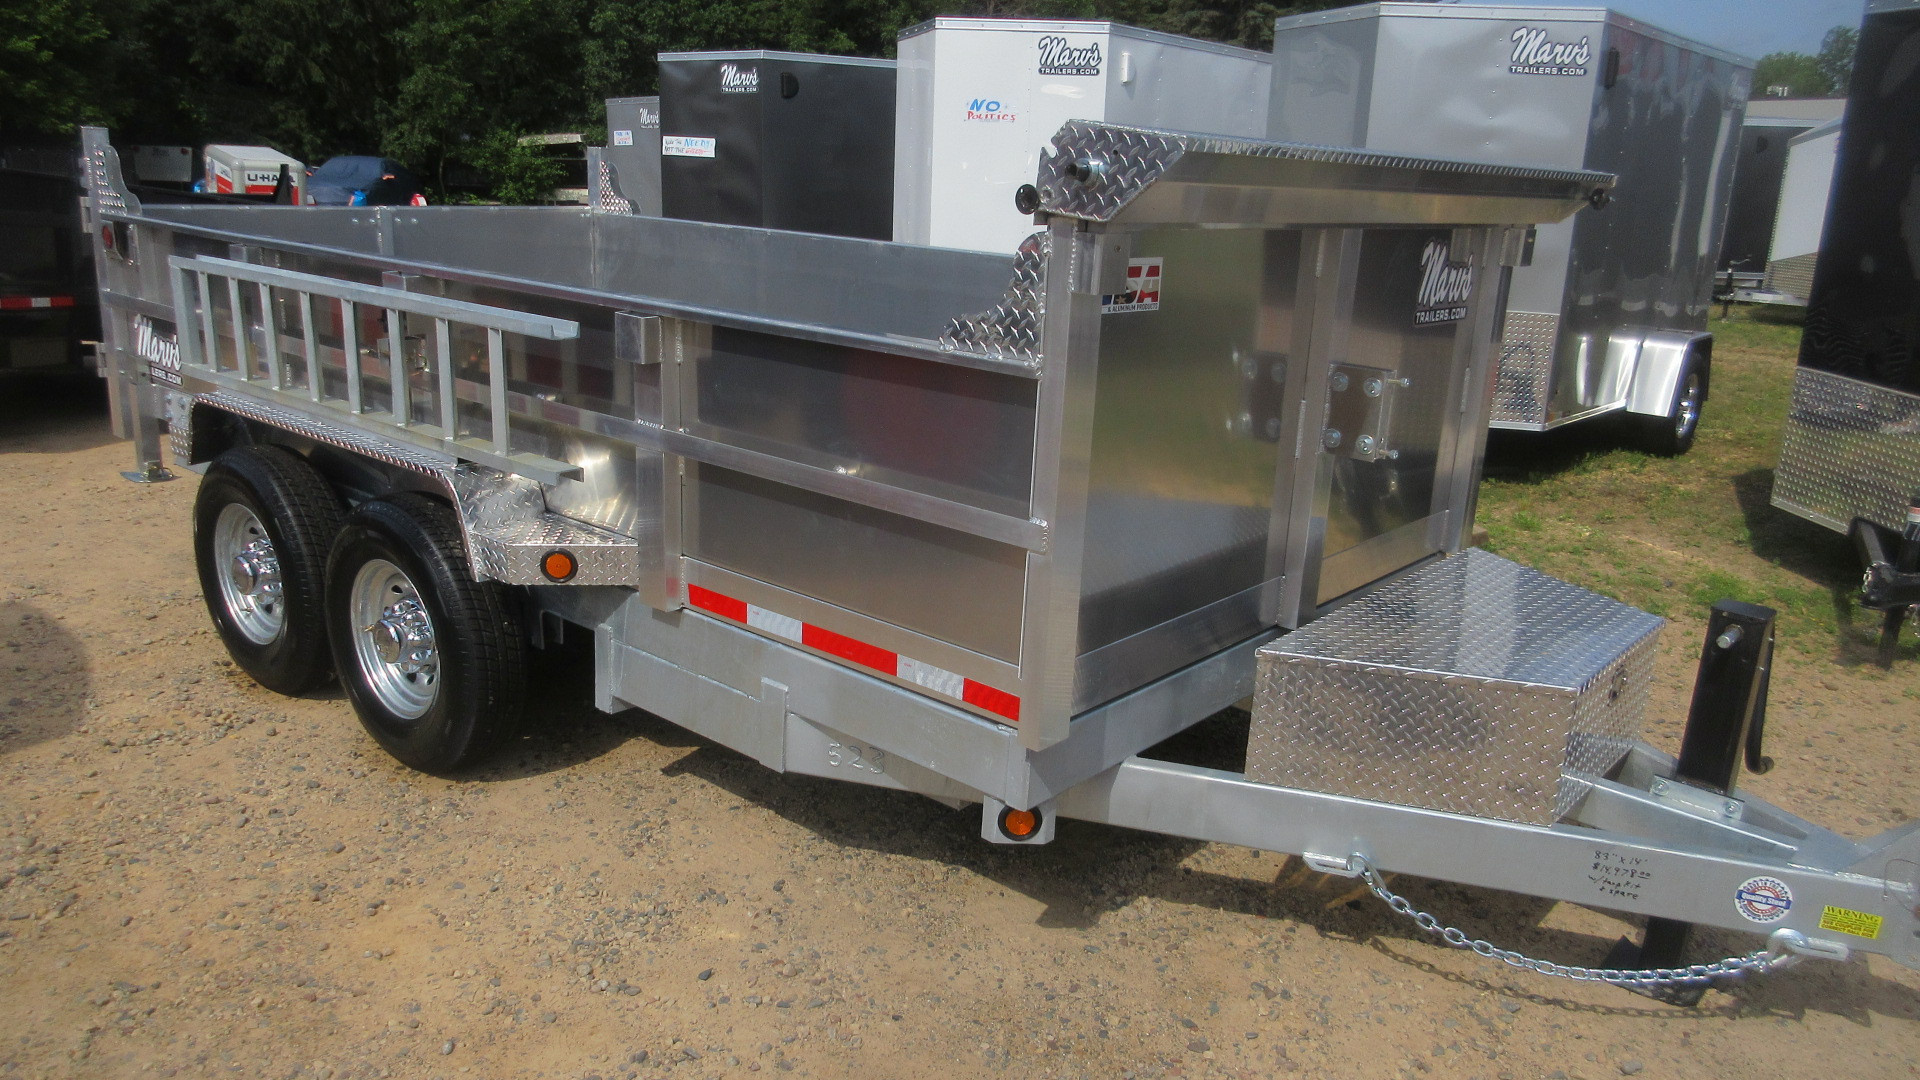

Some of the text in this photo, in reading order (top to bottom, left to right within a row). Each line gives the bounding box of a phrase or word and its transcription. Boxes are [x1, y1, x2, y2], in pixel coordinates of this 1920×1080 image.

[1039, 36, 1101, 67] Marv's
[1511, 27, 1591, 65] Marv's
[721, 64, 759, 87] Marv's
[1511, 65, 1585, 76] TRAILERS.COM
[969, 98, 1001, 112] NO
[1418, 241, 1473, 307] Marv's
[1112, 304, 1136, 312] ALUMINUM
[1415, 307, 1467, 324] TRAILERS.COM
[133, 313, 181, 371] Marv's
[828, 742, 885, 775] 523
[1740, 891, 1767, 905] Quality
[1825, 904, 1880, 923] WARNING
